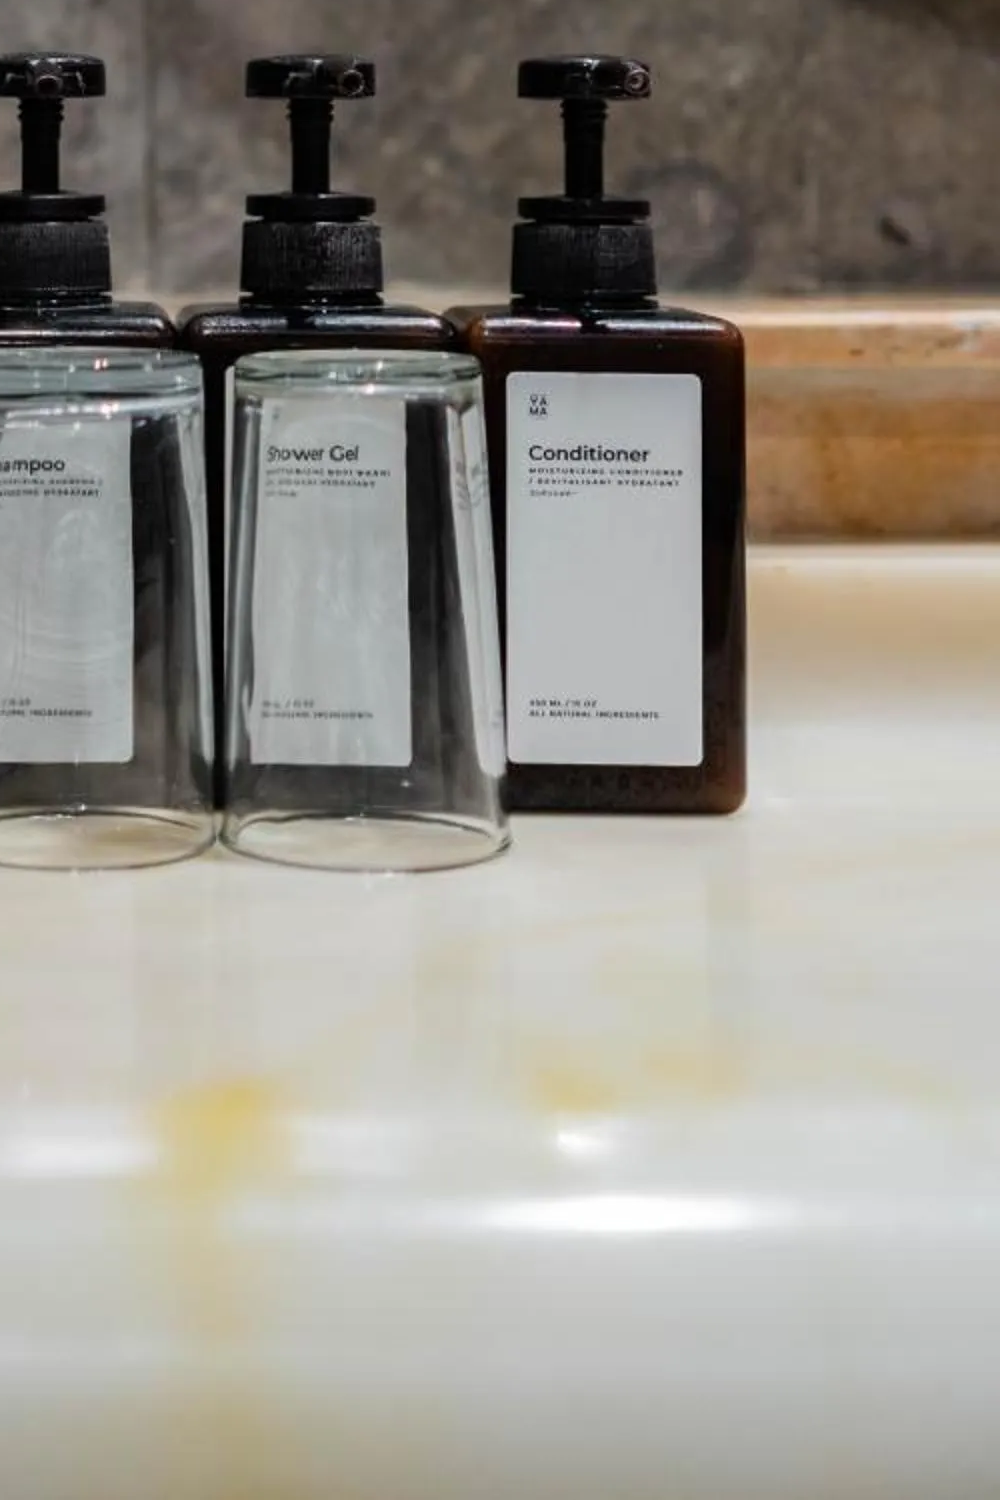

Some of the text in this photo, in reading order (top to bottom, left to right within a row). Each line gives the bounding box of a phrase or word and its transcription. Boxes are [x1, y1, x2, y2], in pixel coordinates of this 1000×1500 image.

[267, 444, 360, 462] Shower Gel
[529, 445, 650, 462] Conditioner
